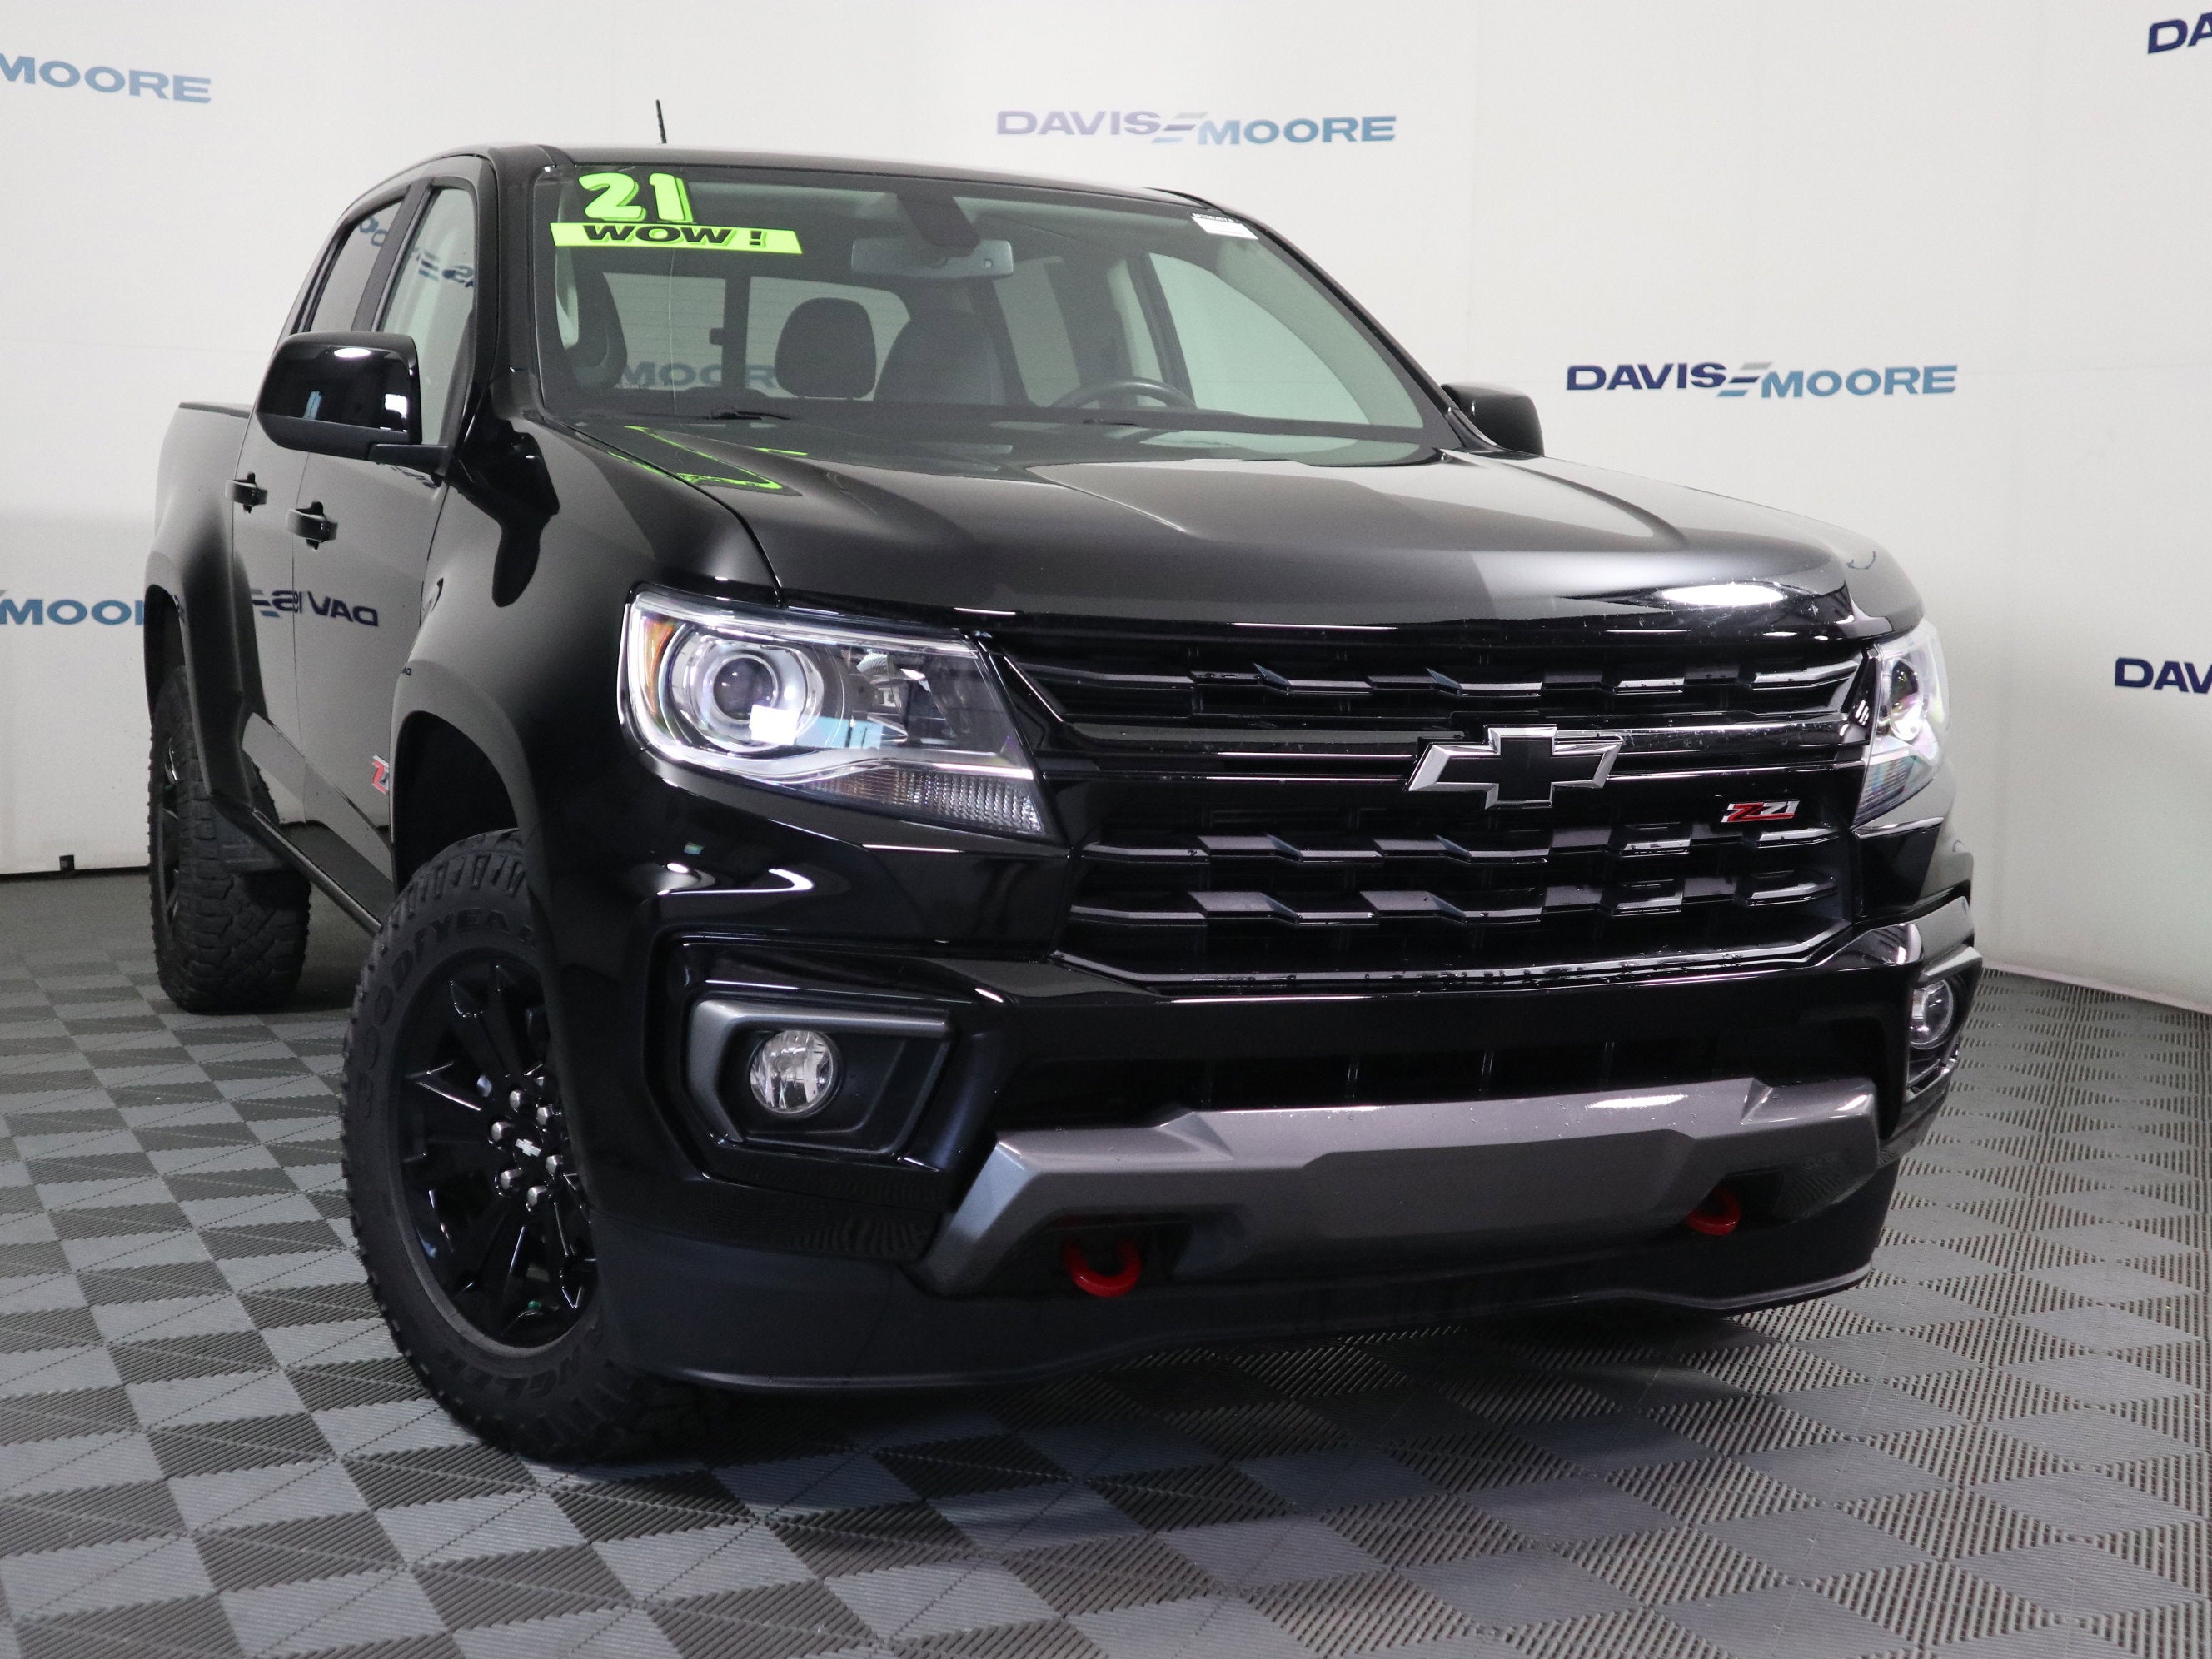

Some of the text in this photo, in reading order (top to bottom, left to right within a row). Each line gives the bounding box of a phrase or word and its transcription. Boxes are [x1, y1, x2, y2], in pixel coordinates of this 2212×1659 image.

[0, 52, 212, 104] MOORE
[996, 110, 1397, 145] DAVIS MOORE
[578, 172, 694, 222] 21
[1567, 361, 1958, 399] DAVIS MOORE
[2115, 657, 2212, 694] DAV
[1721, 800, 1800, 823] Z71
